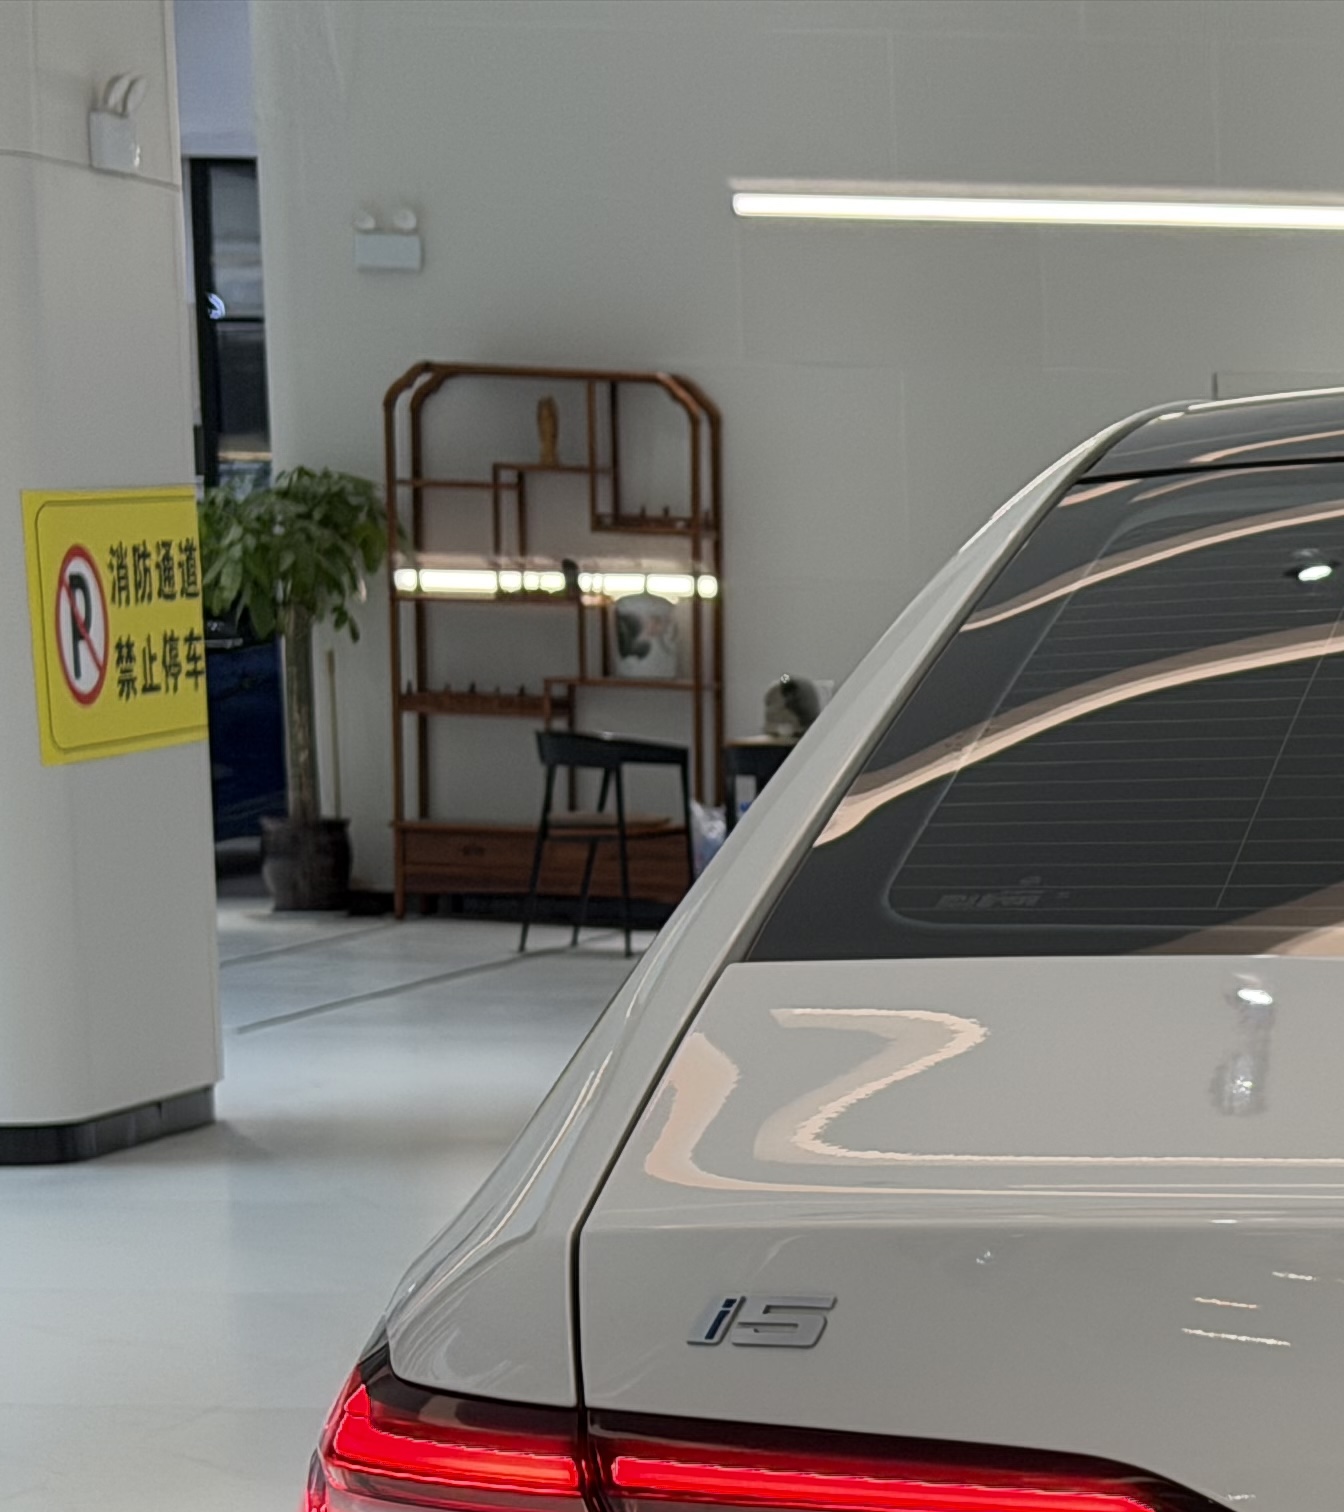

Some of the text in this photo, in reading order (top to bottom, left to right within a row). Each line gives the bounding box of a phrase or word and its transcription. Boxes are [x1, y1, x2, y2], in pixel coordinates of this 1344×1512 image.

[108, 537, 201, 608] 消防通道
[114, 628, 205, 703] 禁止停车
[686, 1293, 838, 1350] i5
